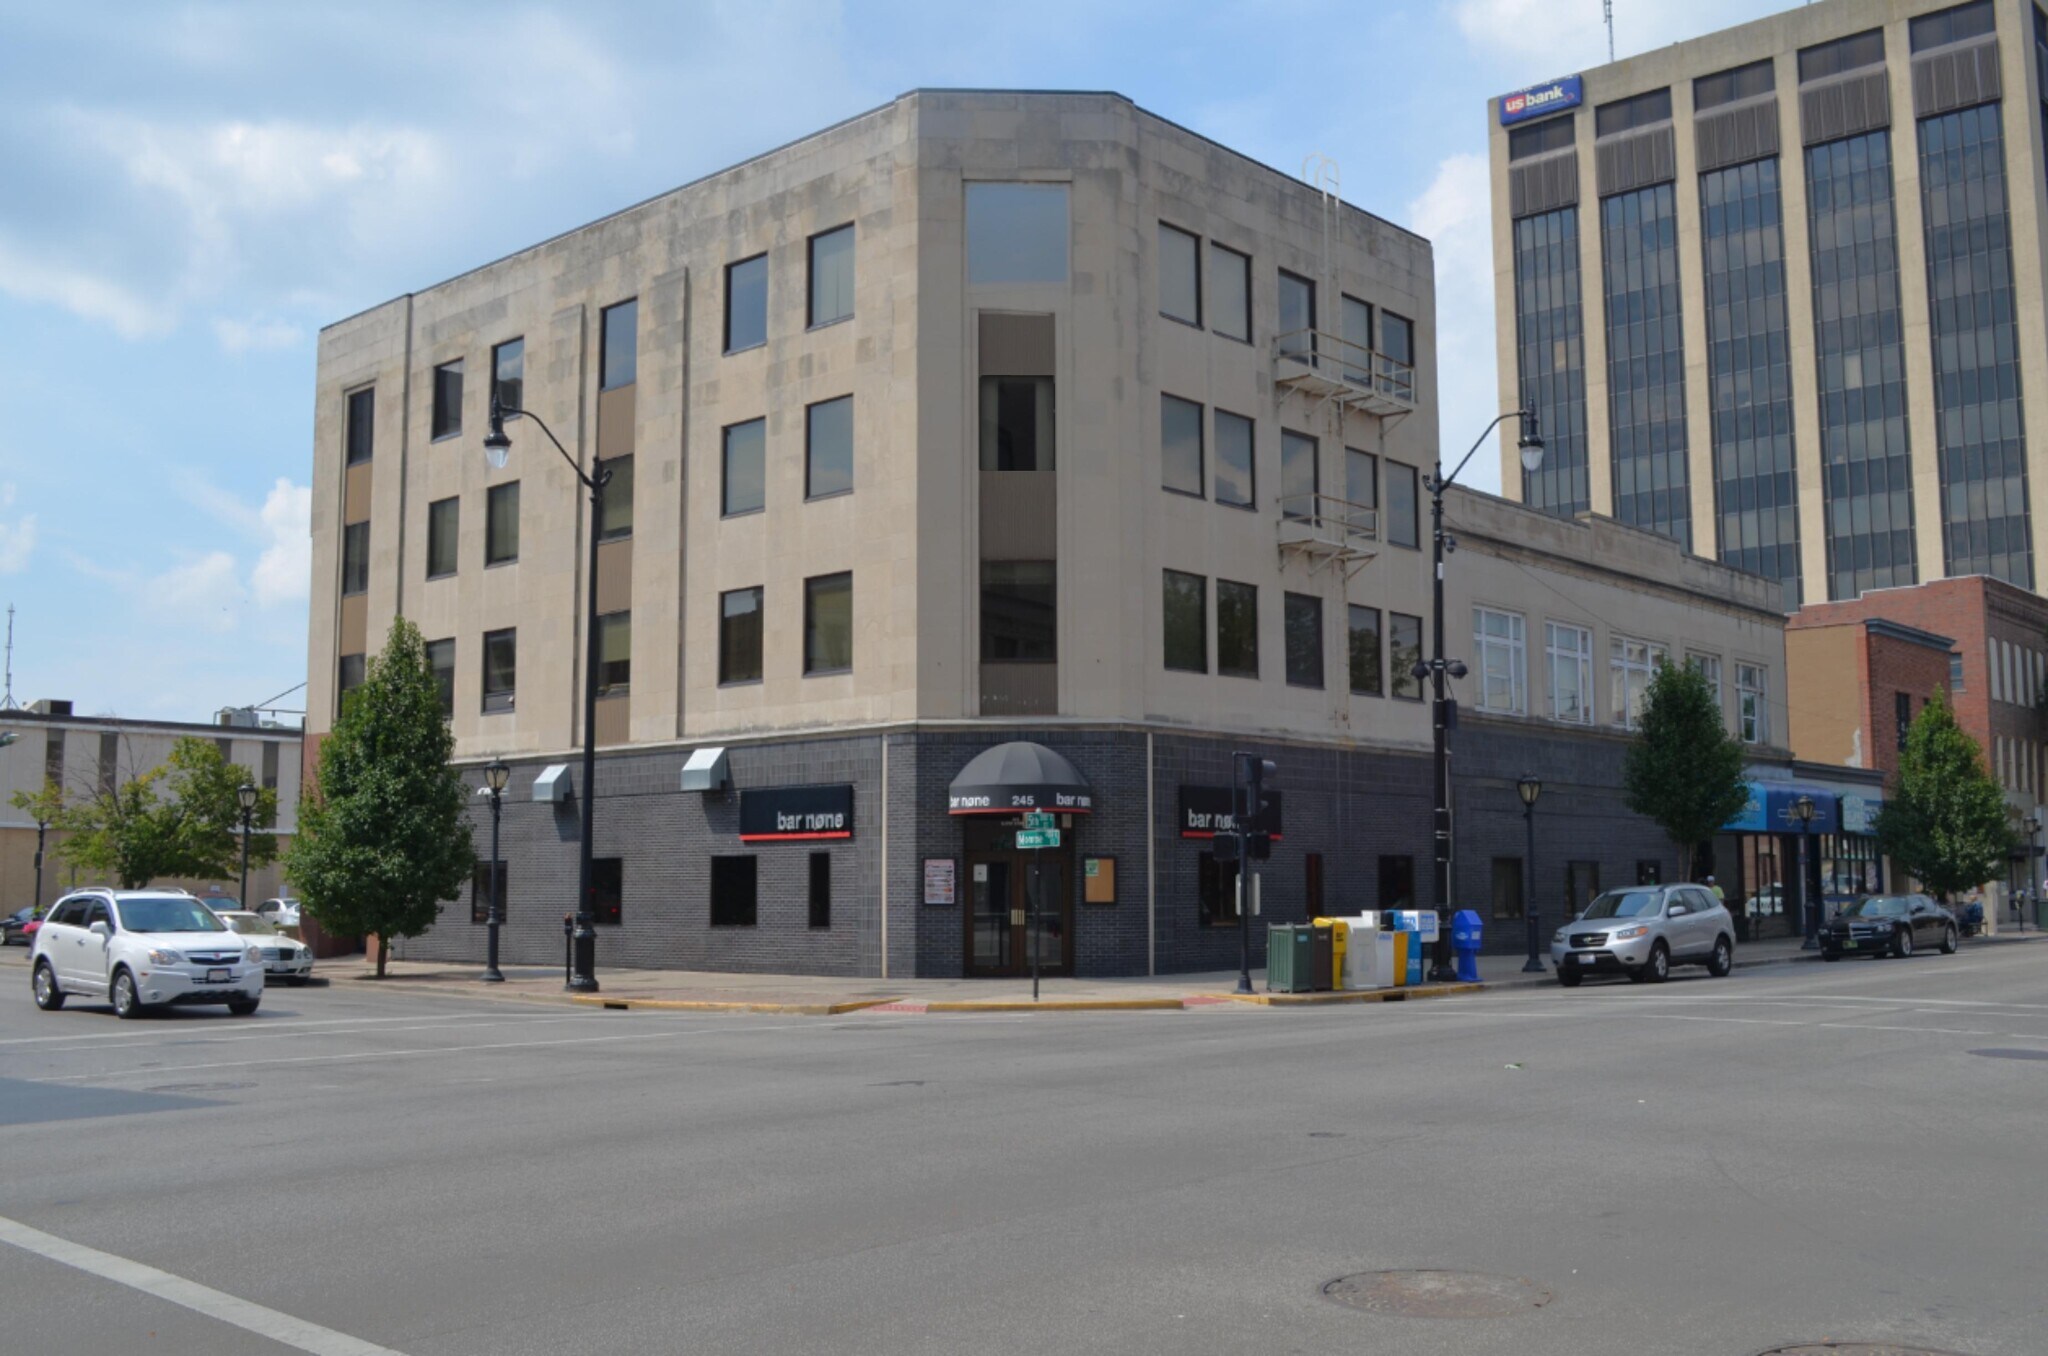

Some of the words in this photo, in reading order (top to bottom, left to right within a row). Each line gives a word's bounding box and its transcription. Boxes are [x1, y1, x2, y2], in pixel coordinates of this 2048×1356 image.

[1505, 97, 1524, 112] us
[1526, 86, 1564, 107] bank
[1012, 795, 1035, 806] 245
[1056, 793, 1076, 806] bar
[777, 811, 802, 831] bar
[1187, 808, 1212, 828] bar
